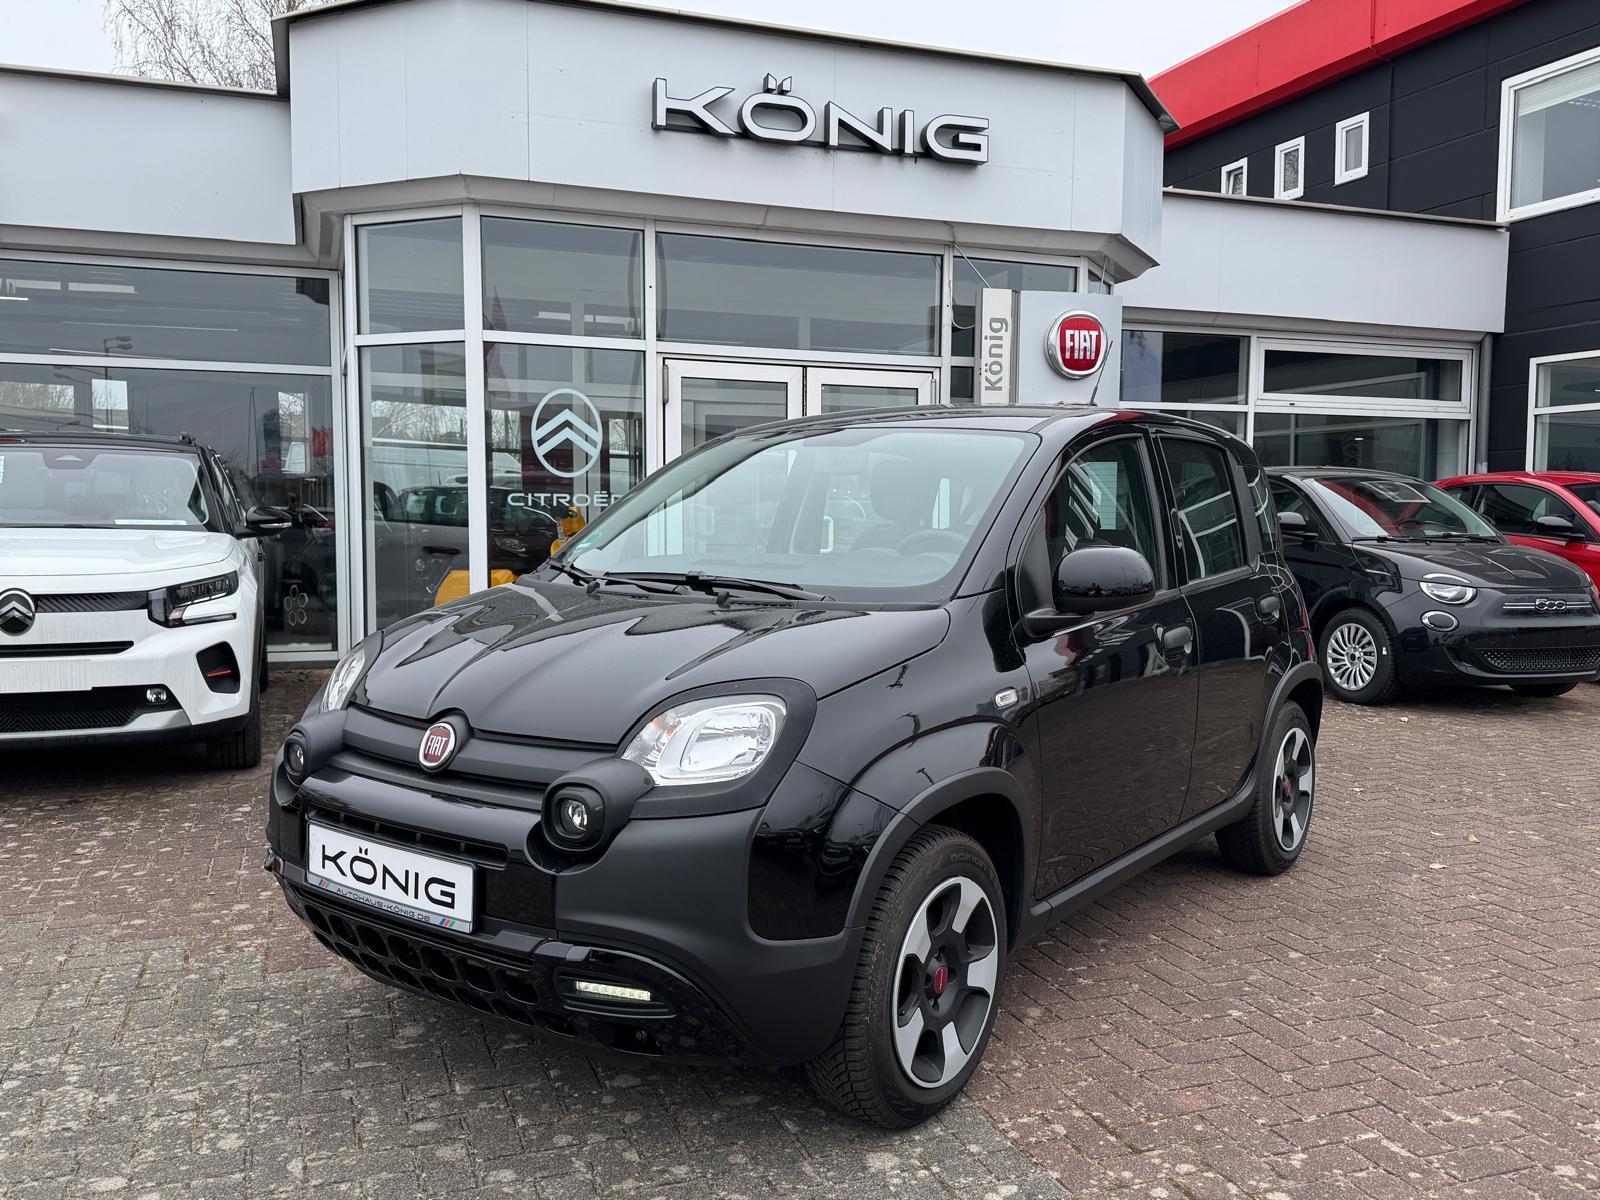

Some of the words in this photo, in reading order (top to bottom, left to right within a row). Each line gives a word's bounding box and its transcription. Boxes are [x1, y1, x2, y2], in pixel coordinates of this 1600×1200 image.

[651, 72, 990, 165] KÖNIG
[983, 317, 1008, 392] König
[1065, 329, 1099, 360] FIAT
[425, 735, 448, 756] FIAT
[322, 845, 456, 909] KÖNIG
